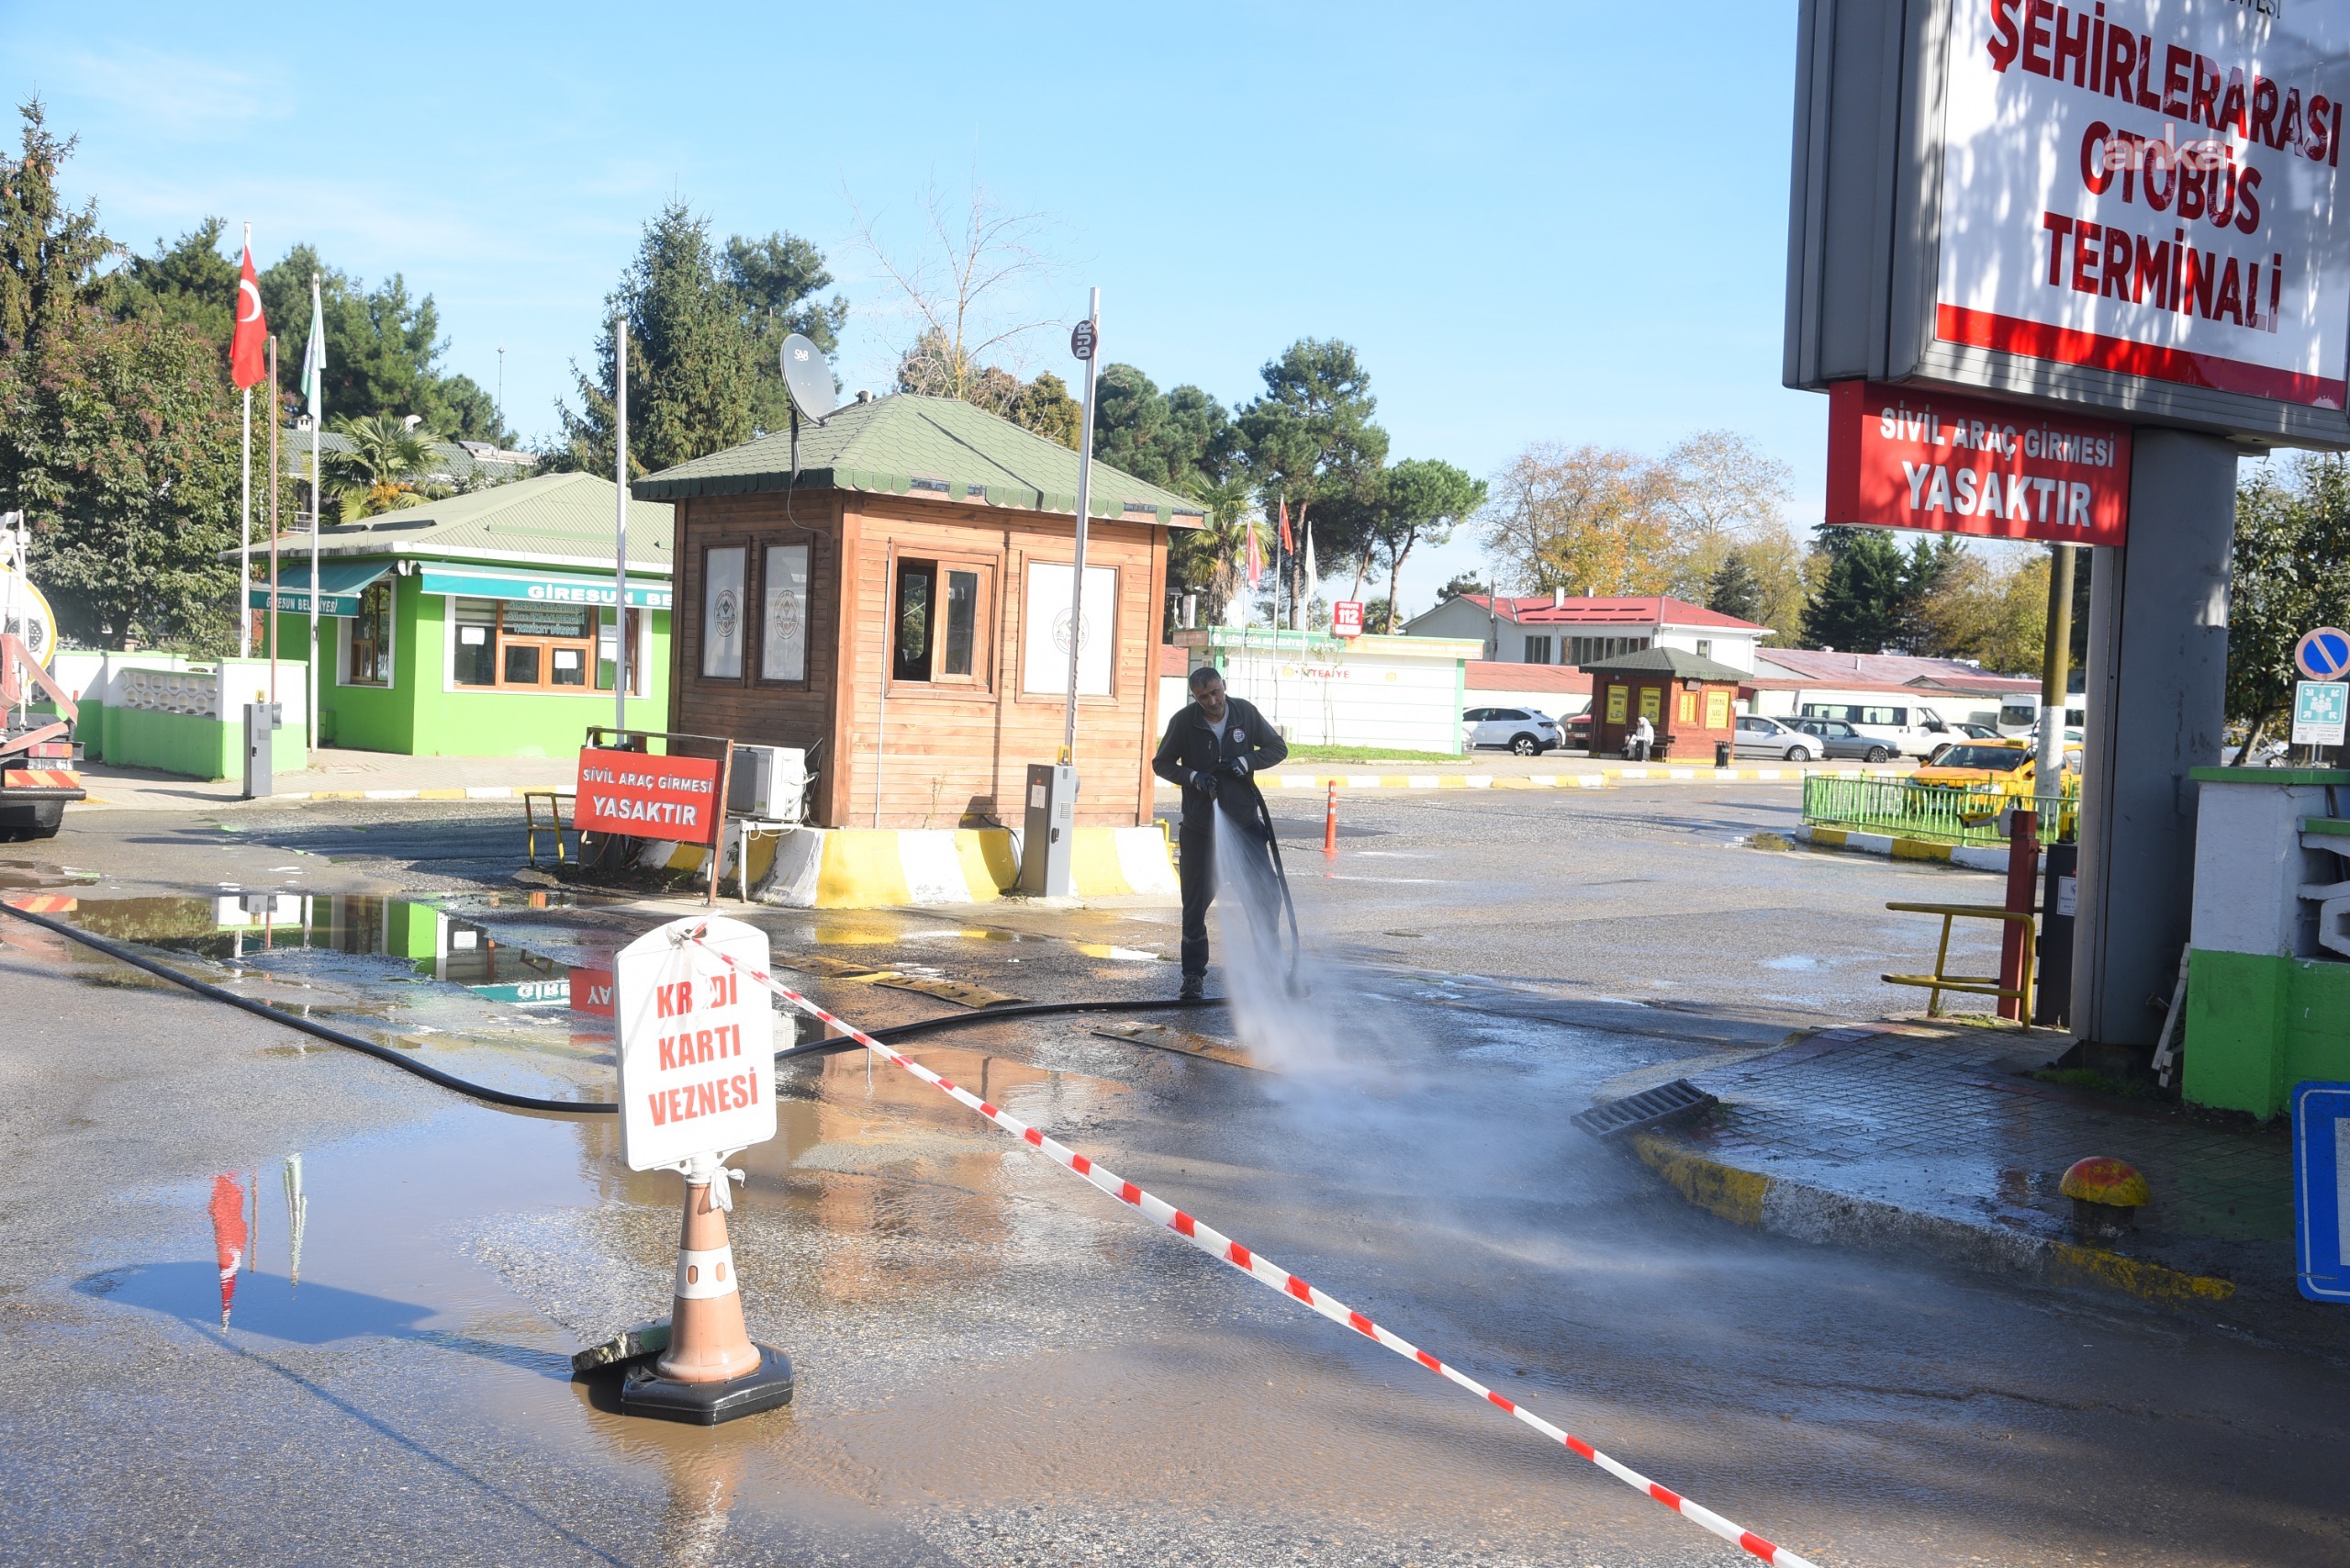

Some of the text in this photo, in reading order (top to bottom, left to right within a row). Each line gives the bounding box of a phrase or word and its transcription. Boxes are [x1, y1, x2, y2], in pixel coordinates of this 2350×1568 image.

[1986, 0, 2343, 167] ŞEHİRLERARASI
[2080, 120, 2262, 235] OTOBÜS
[2043, 210, 2282, 333] TERMİNALİ
[1879, 399, 2115, 468] SİVİL ARAÇ GİRMESİ
[1901, 460, 2092, 528] YASAKTIR
[1337, 609, 1359, 624] 112
[583, 766, 714, 794] SİVİL ARAÇ GİRMESİ
[592, 795, 698, 826] YASAKTIR
[656, 967, 738, 1018] KRDİ
[658, 1023, 742, 1071] KARTI
[648, 1066, 759, 1127] VEZNESİ
